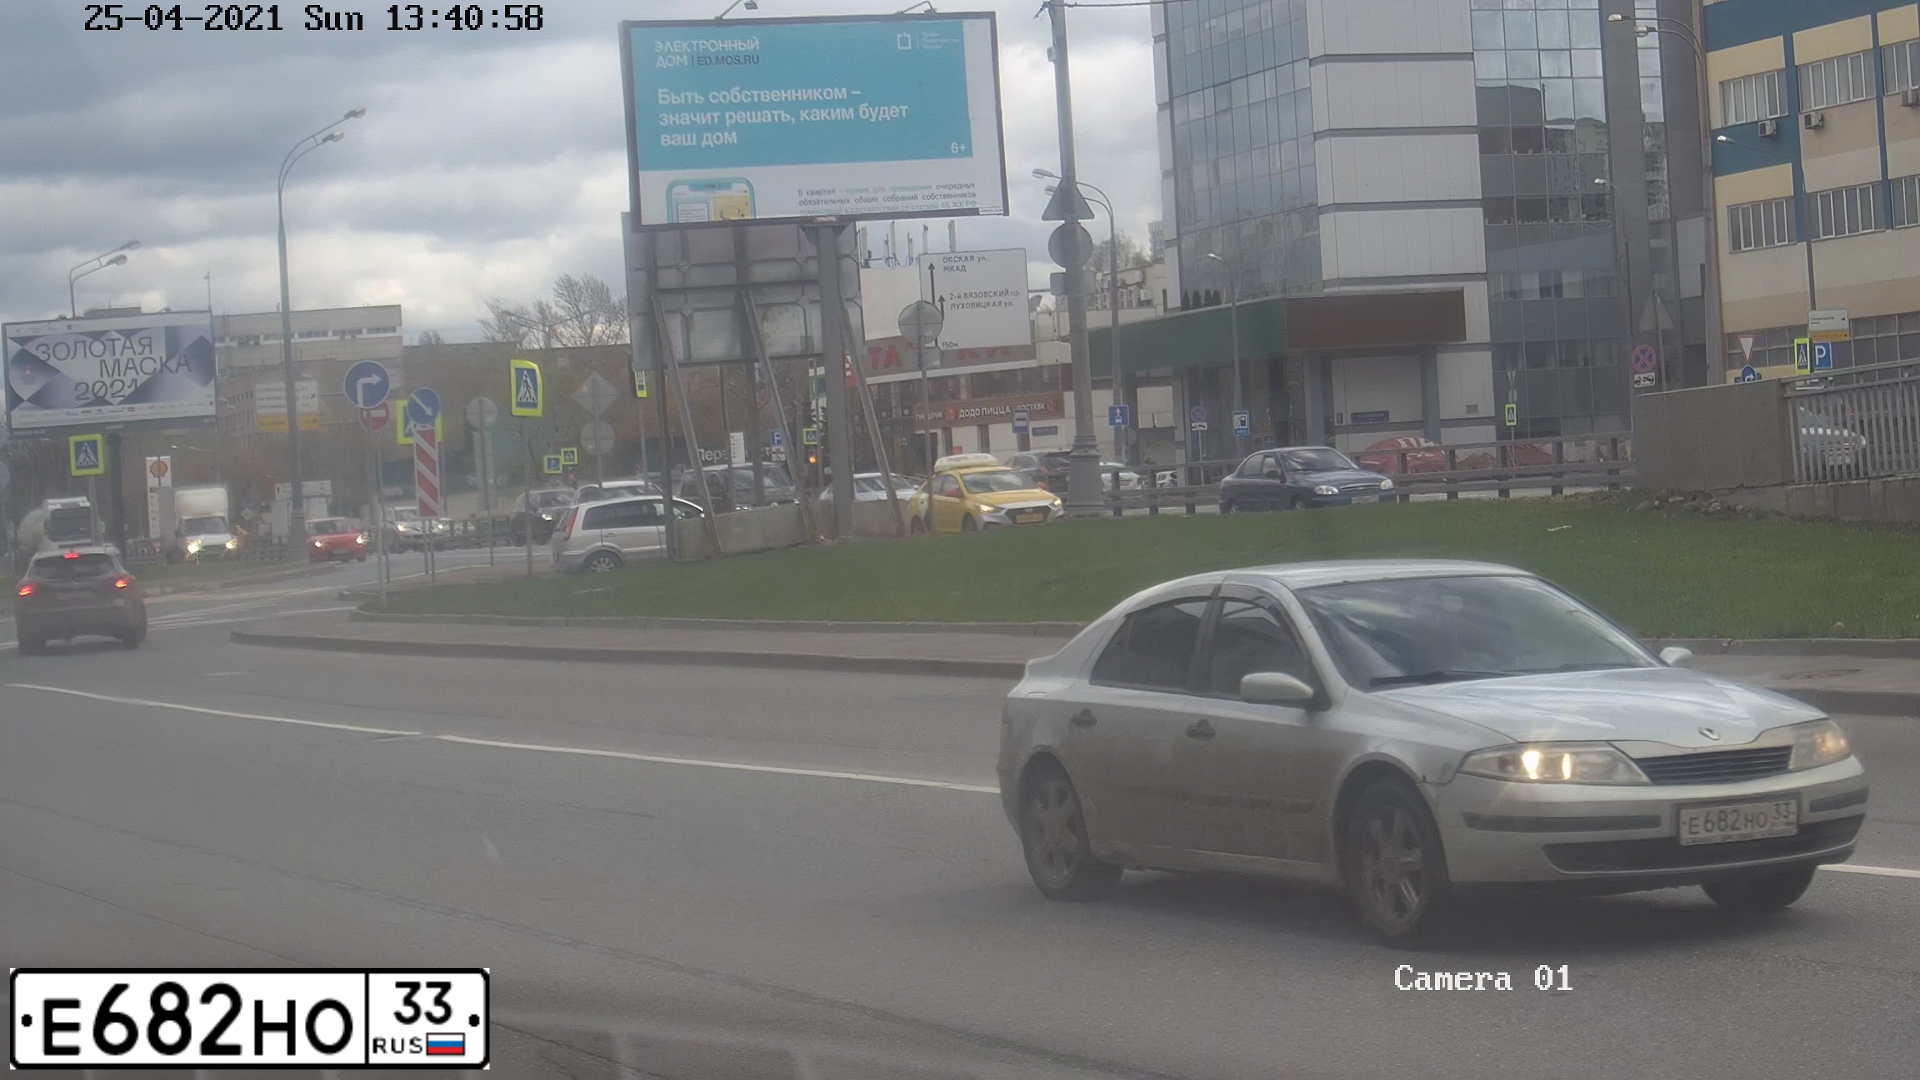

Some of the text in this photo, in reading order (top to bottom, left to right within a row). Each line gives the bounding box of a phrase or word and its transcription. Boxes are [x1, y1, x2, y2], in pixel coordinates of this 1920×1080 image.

[654, 37, 760, 53] ЭЛЕКТРОННЫЙ
[656, 55, 760, 69] ДОМ ED.MOS.RU
[657, 88, 704, 105] Быть
[708, 86, 847, 104] собственником
[658, 103, 909, 127] значит решать, каким будет
[661, 131, 737, 147] ваш дом
[951, 142, 966, 154] 6+
[806, 188, 836, 198] квартал
[936, 182, 975, 191] очередных
[799, 197, 850, 207] обязательных
[883, 193, 918, 203] собраний
[922, 191, 977, 202] собственников
[943, 255, 975, 263] ОКСКАЯ
[963, 289, 1009, 300] ВЯЗОВСКИЙ
[950, 301, 1003, 310] ЛУХОВИЦКАЯ
[36, 336, 153, 362] ЗОЛОТАЯ
[100, 355, 192, 378] МАСКА
[74, 378, 139, 400] 2021
[959, 409, 981, 419] ДОДО
[982, 405, 1011, 416] ПИЦЦА
